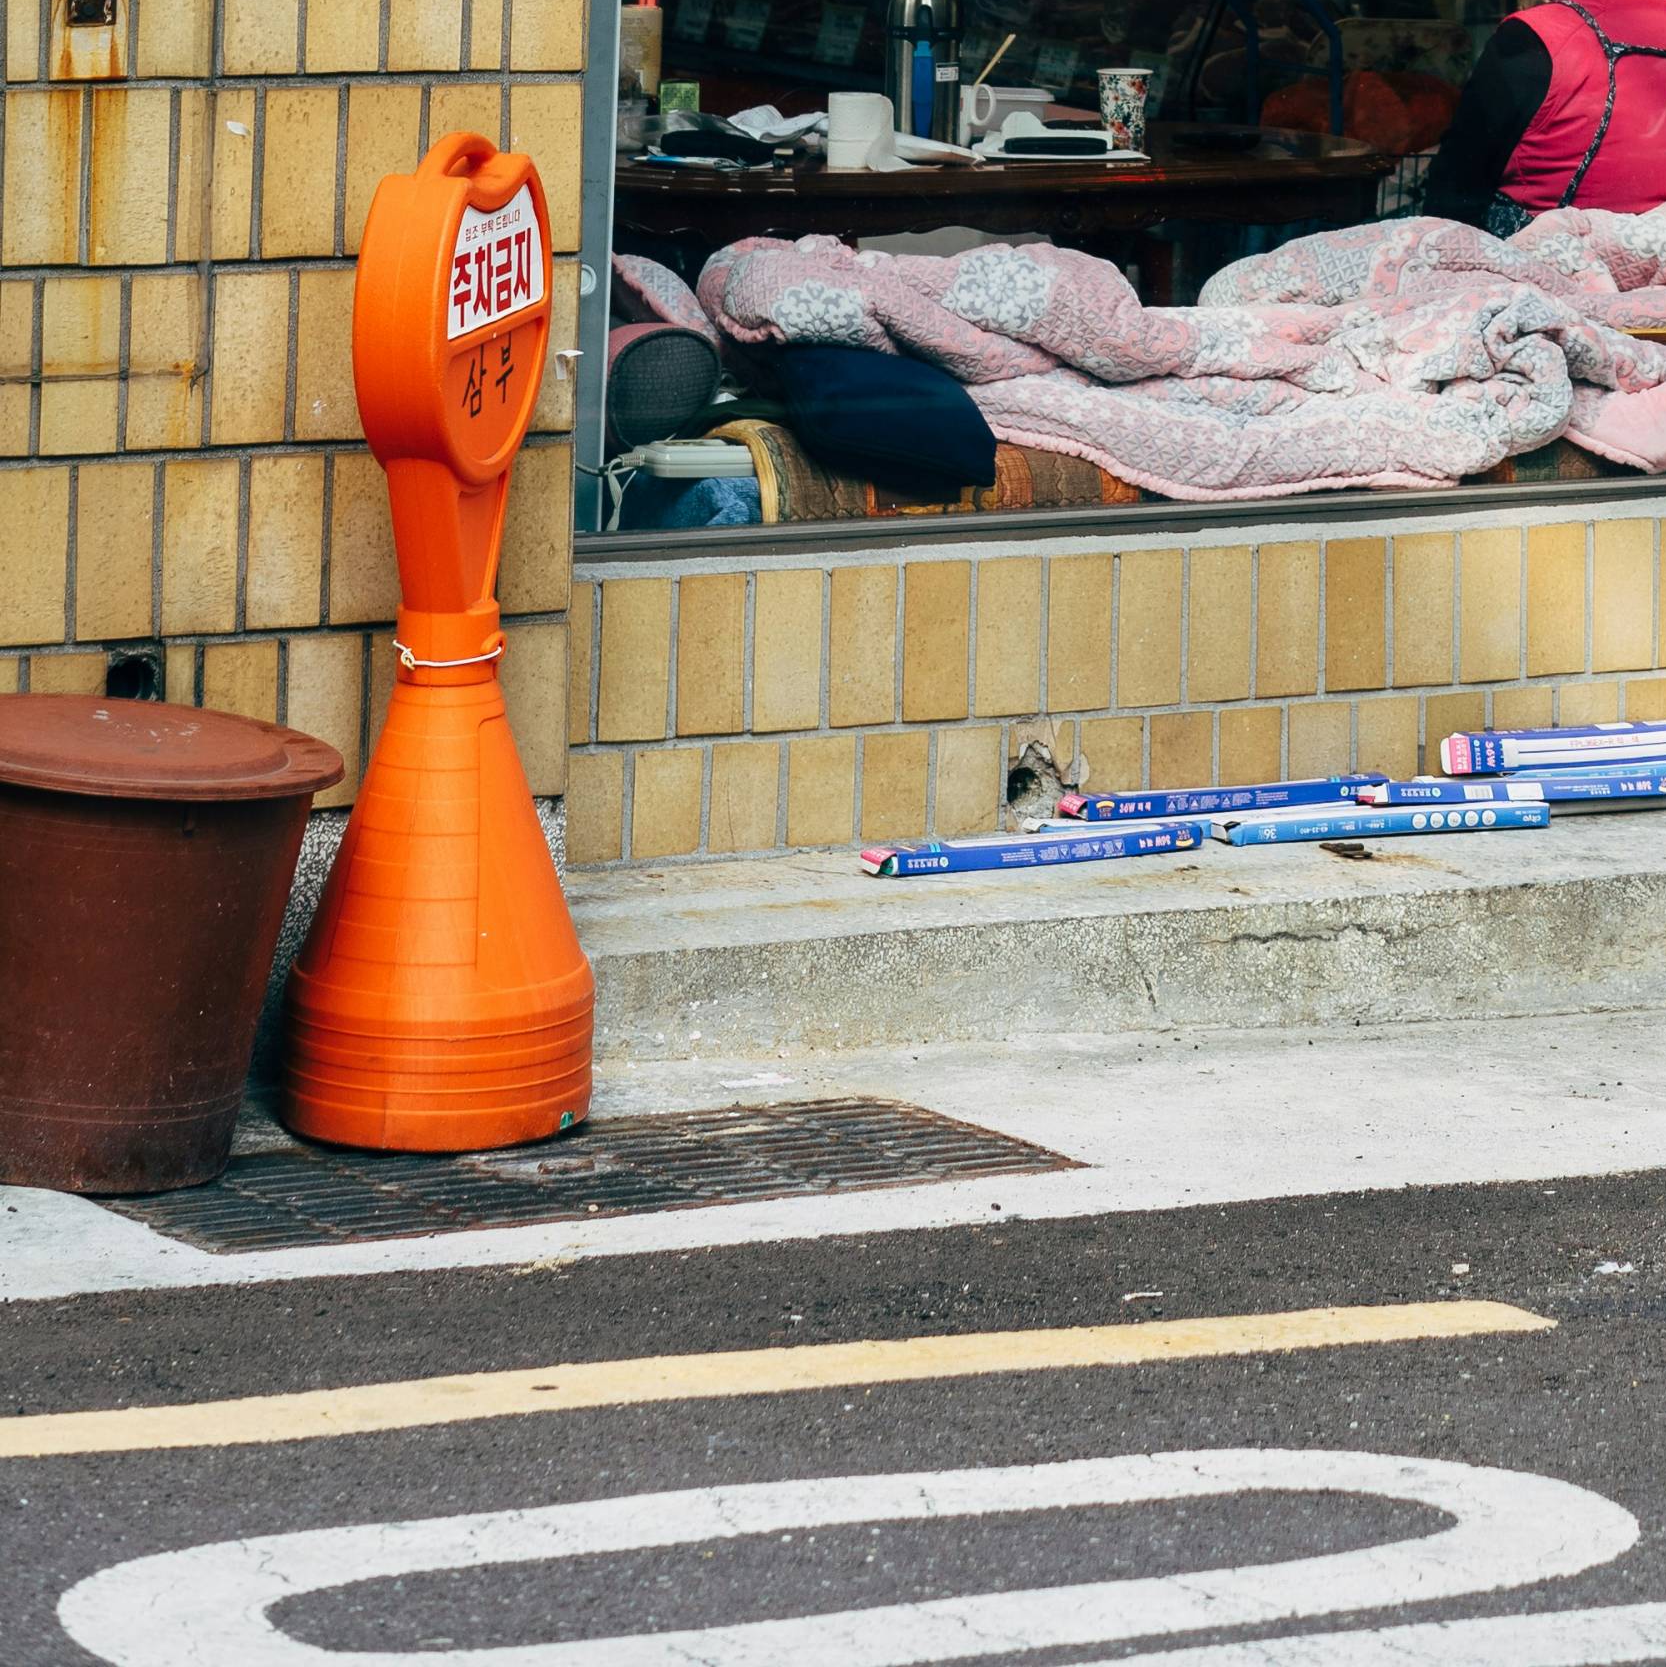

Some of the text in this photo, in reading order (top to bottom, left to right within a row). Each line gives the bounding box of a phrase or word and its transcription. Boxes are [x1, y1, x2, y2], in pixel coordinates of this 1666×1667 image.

[480, 219, 495, 238] 부탁
[495, 210, 521, 232] 드립니다
[453, 227, 531, 327] 주차금지
